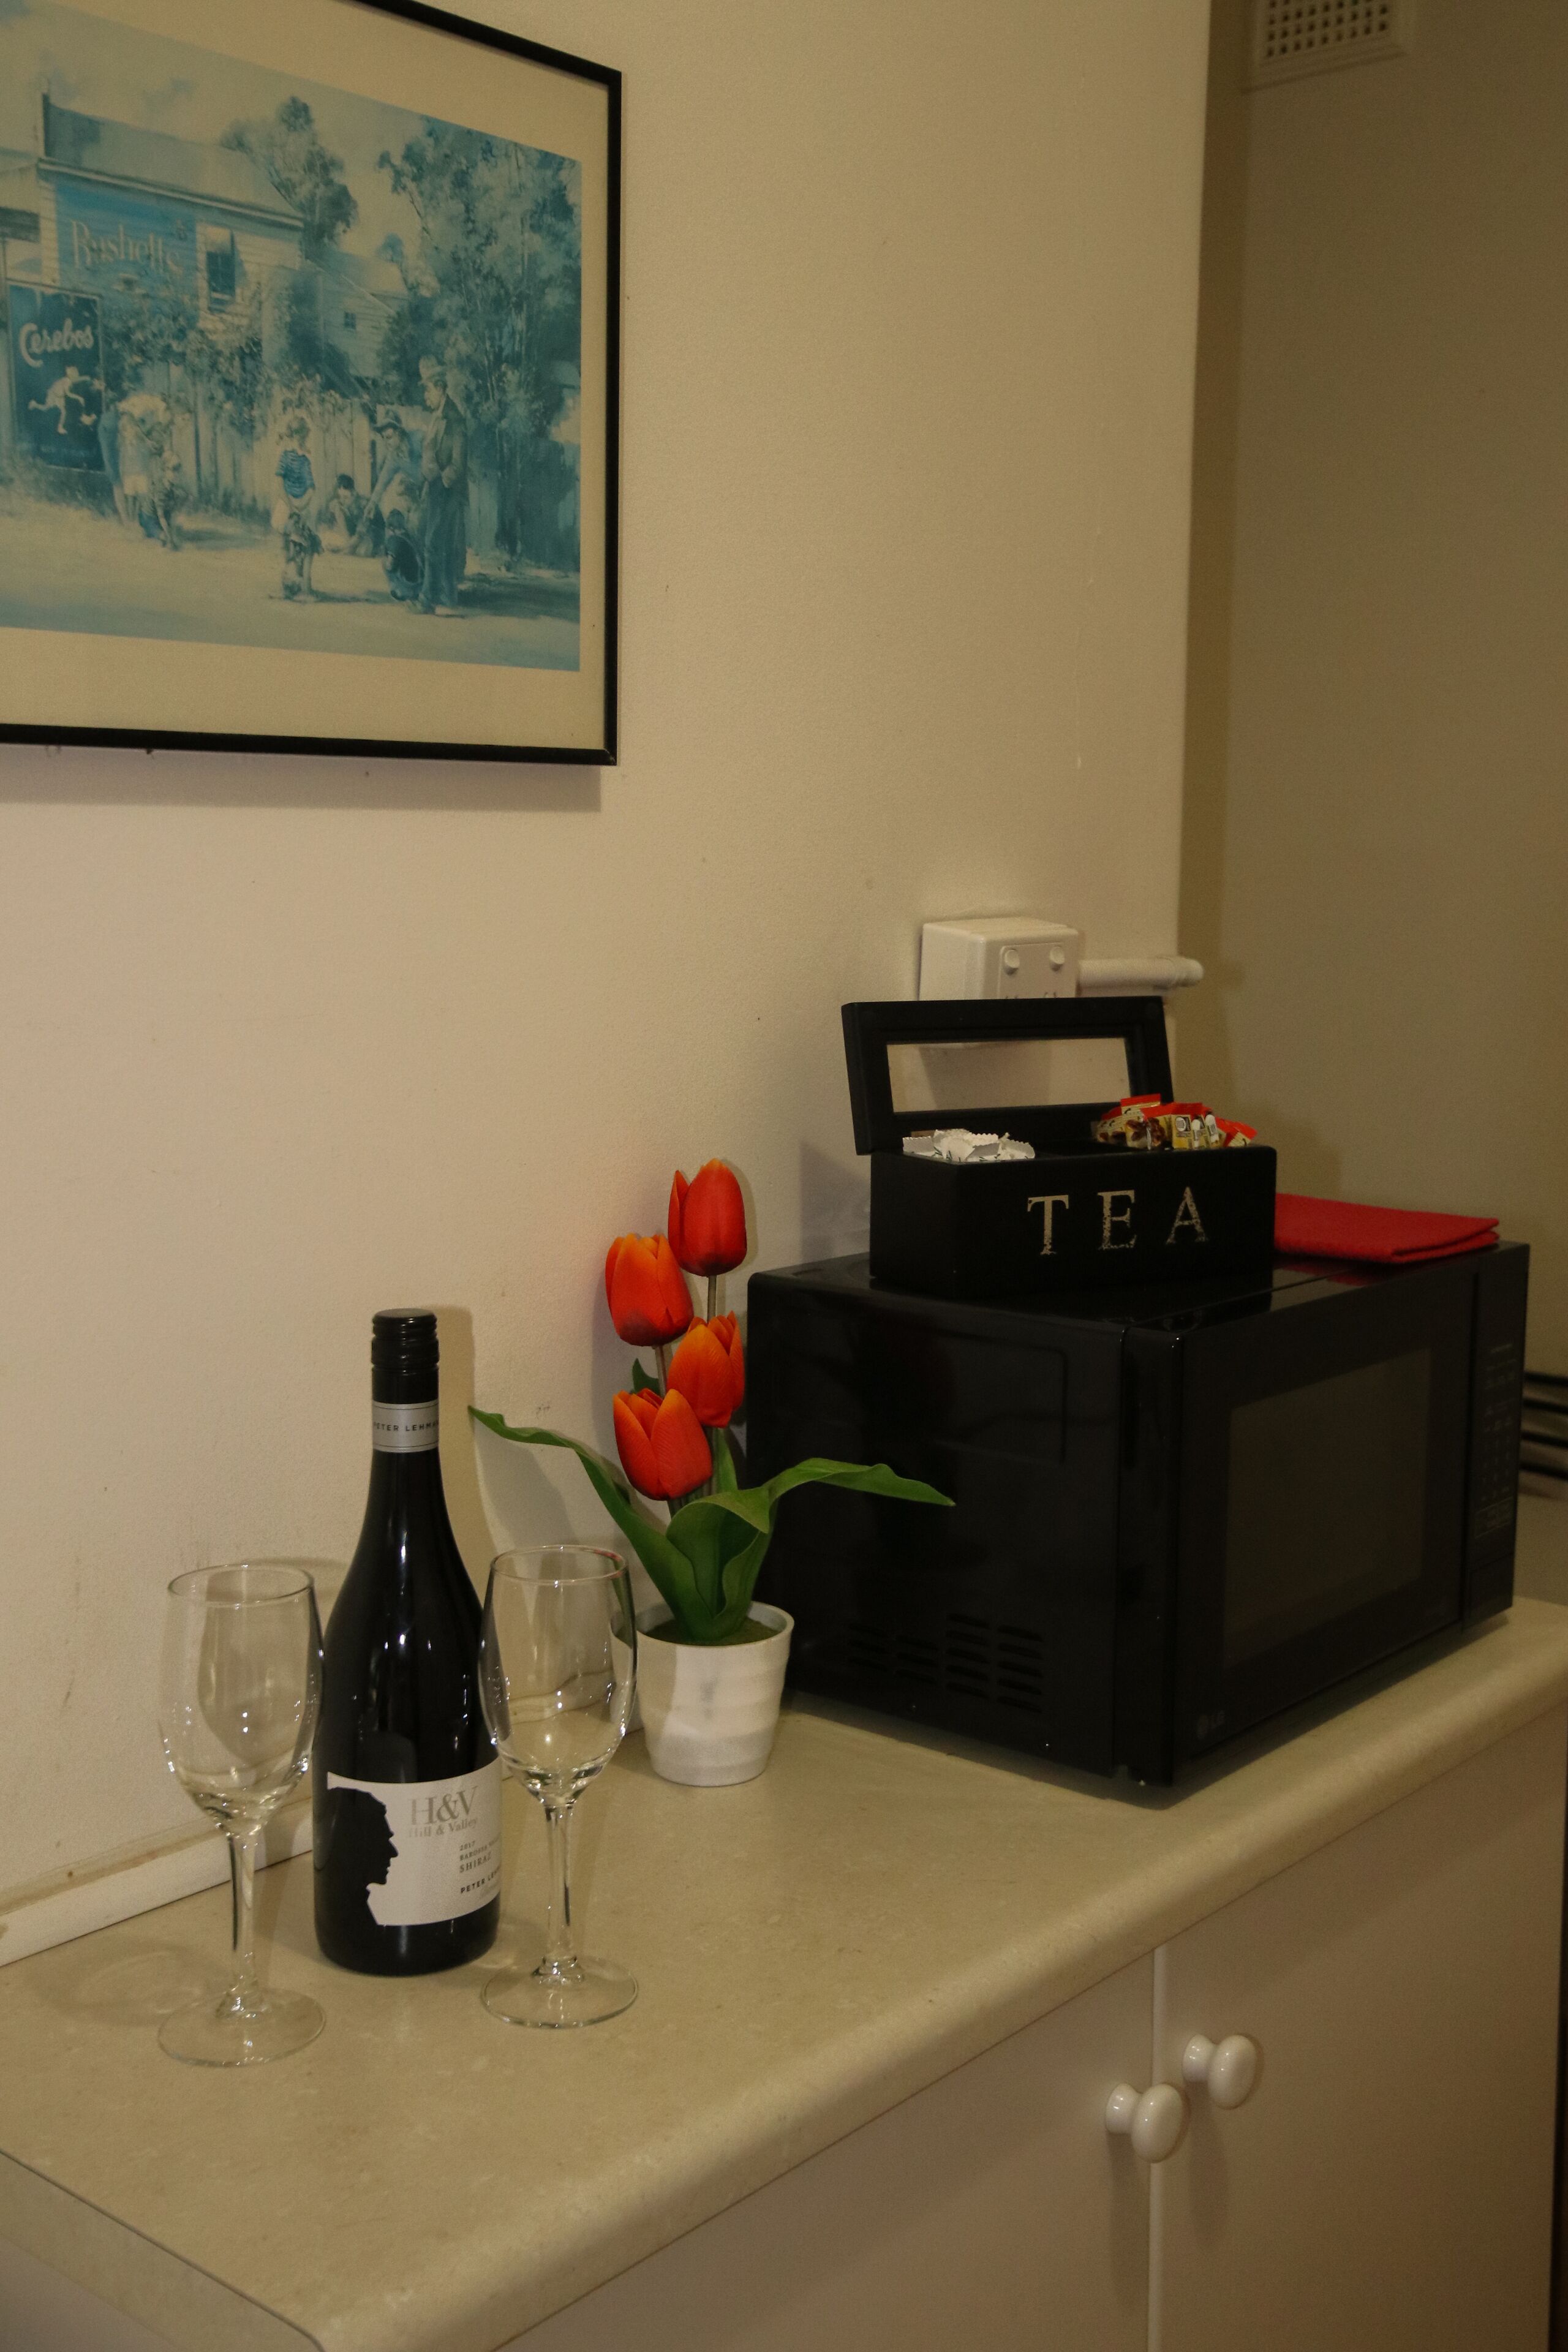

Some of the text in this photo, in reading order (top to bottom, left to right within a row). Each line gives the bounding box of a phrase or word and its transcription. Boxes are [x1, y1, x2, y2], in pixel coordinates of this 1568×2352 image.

[19, 317, 94, 368] Cerebos
[1026, 1186, 1208, 1256] TEA
[408, 1785, 478, 1825] H&V
[409, 1817, 478, 1838] Hill & Valley
[459, 1851, 492, 1874] SHIRAZ
[460, 1878, 486, 1894] PETER
